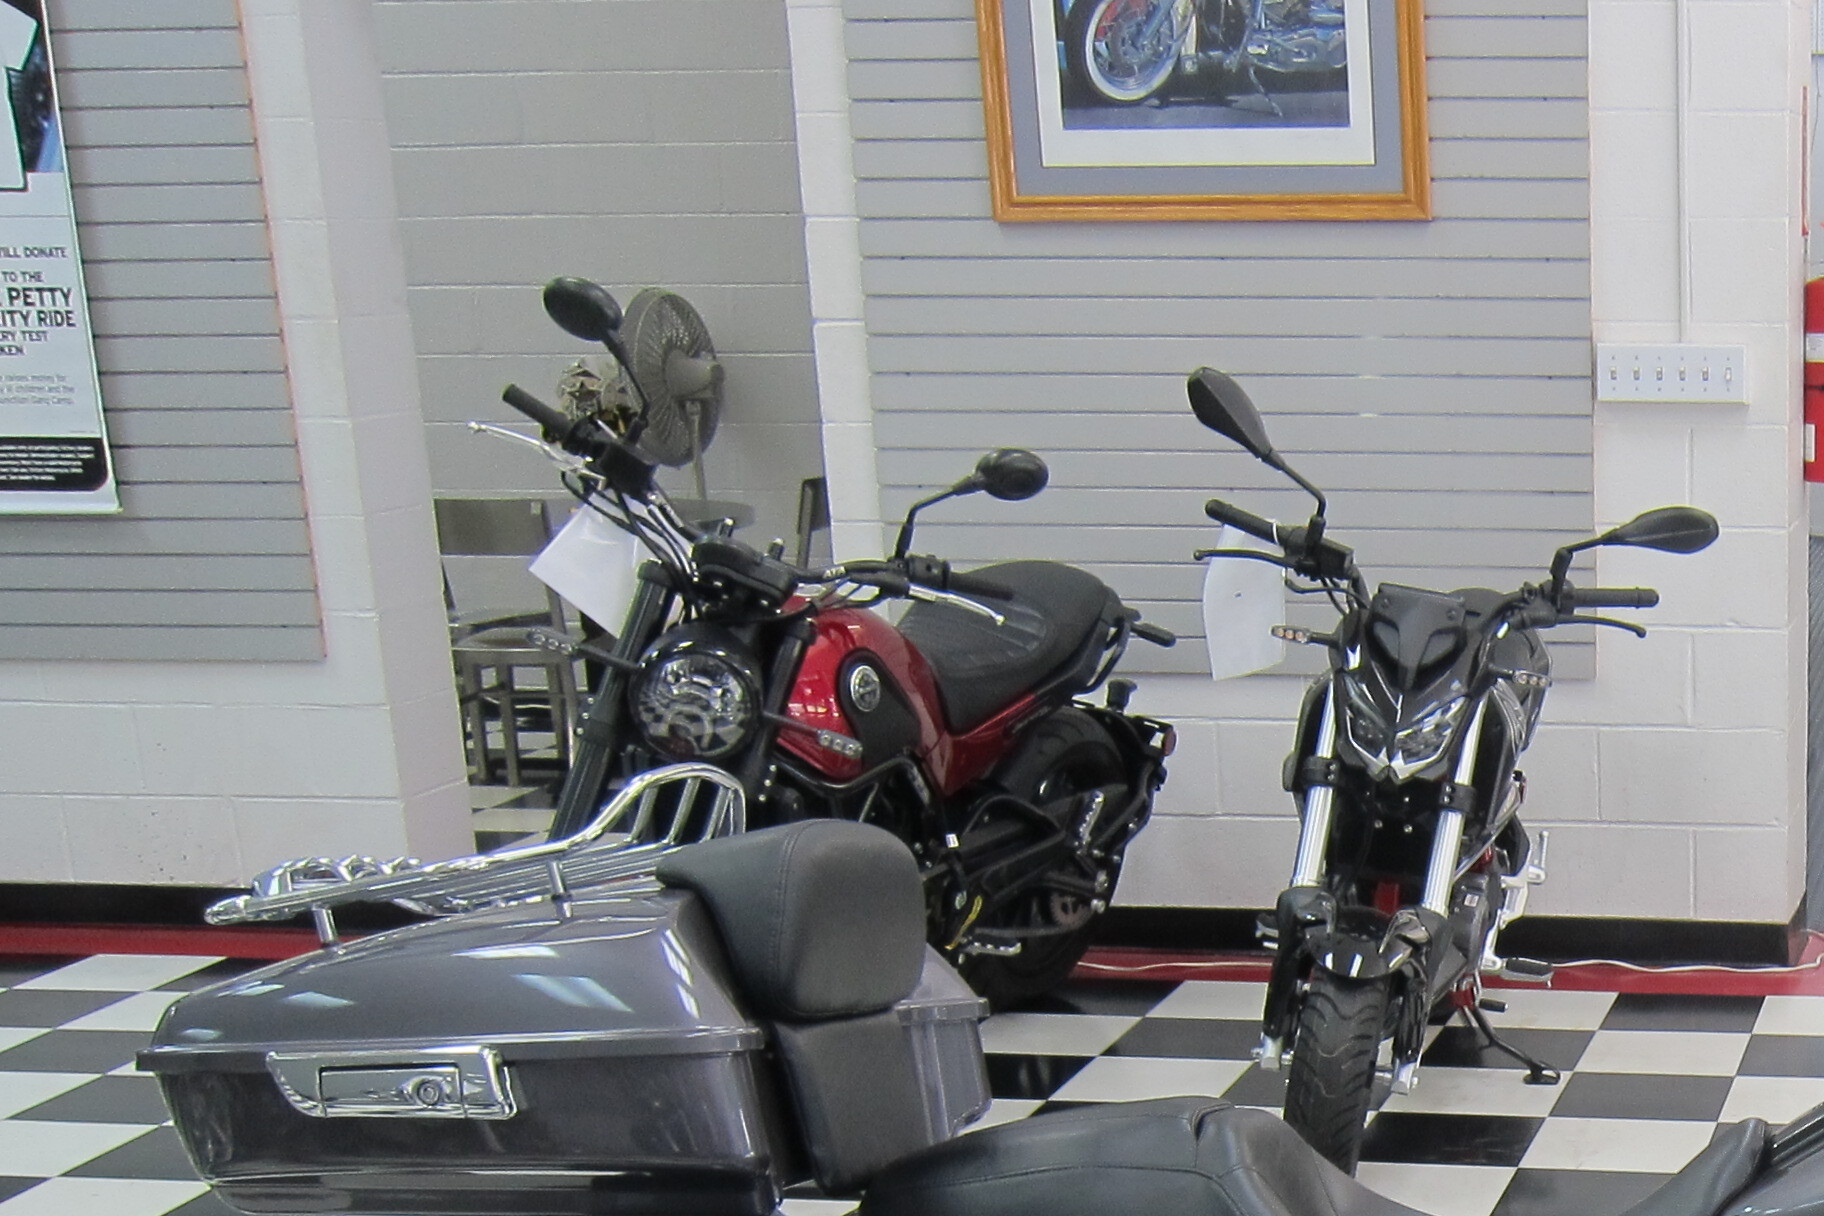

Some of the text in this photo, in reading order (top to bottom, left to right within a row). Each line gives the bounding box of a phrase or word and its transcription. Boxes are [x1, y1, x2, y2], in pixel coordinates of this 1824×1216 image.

[23, 246, 67, 258] DONATE
[1, 270, 44, 282] TO THE
[6, 286, 73, 307] PETTY
[36, 310, 76, 328] RIDE
[21, 330, 48, 342] TEST
